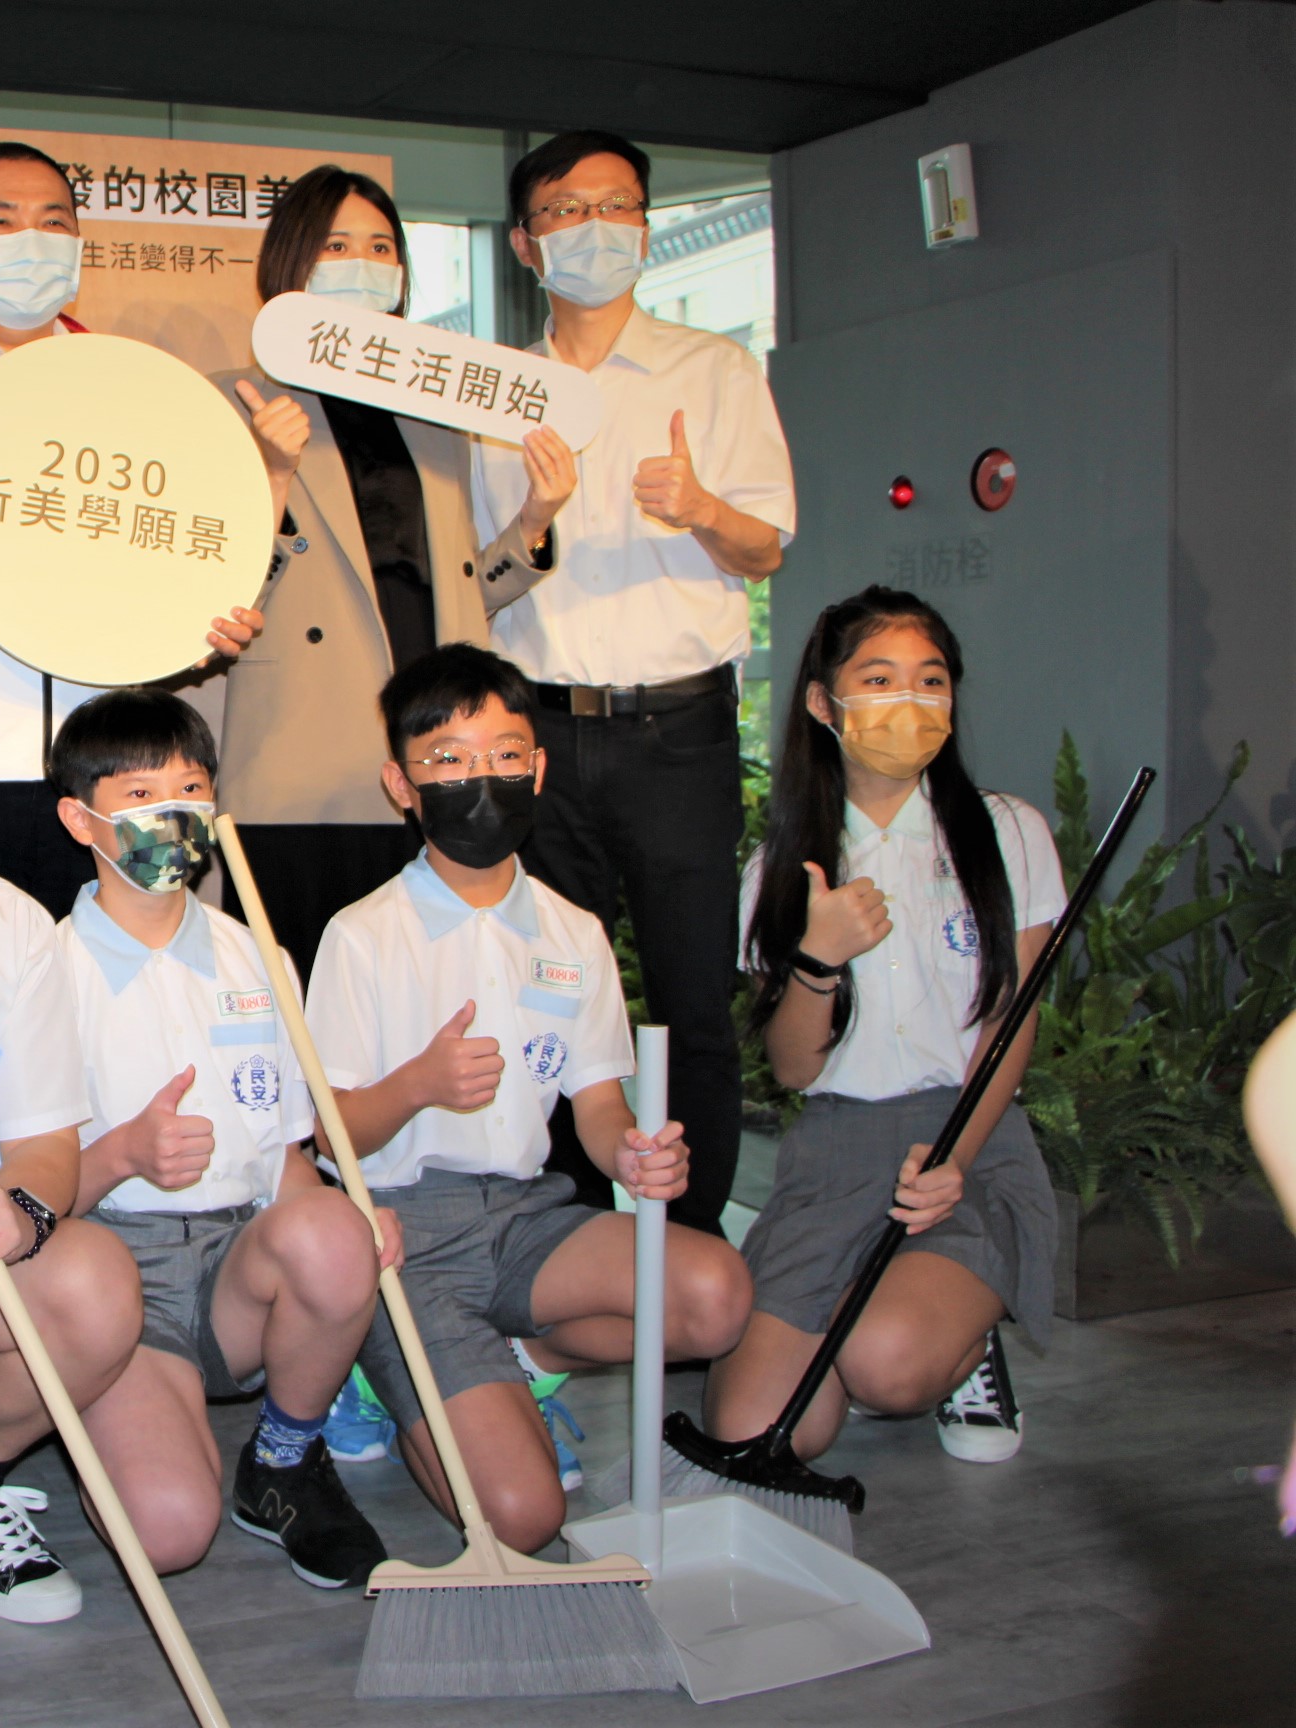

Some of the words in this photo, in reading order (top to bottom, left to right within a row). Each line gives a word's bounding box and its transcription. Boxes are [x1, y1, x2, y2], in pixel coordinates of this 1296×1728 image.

[307, 320, 549, 424] 從生活開始
[39, 439, 167, 498] 2030
[251, 1069, 266, 1100] 民安
